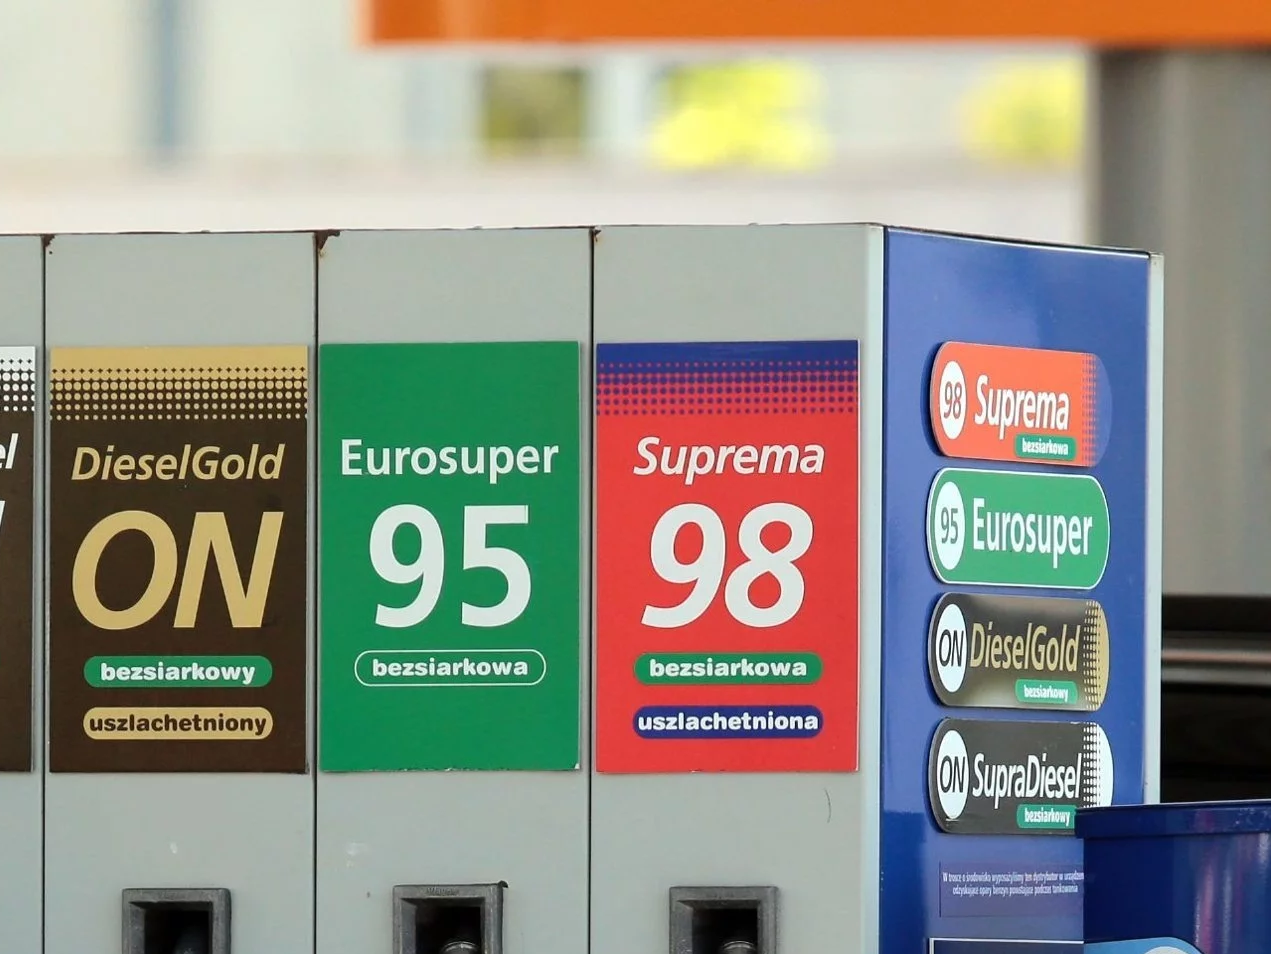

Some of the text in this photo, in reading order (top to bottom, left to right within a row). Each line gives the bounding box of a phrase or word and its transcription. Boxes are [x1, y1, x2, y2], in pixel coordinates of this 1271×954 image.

[944, 381, 963, 420] 98
[974, 374, 1070, 440] Suprema
[71, 444, 285, 481] DieselGold
[341, 438, 559, 484] Eurosuper
[633, 437, 825, 485] Suprema
[1022, 437, 1069, 456] bezsiarkowa
[941, 506, 959, 545] 95
[973, 497, 1093, 569] Eurosuper
[72, 510, 284, 630] ON
[369, 503, 532, 628] 95
[640, 502, 814, 629] 98
[938, 628, 964, 667] ON
[969, 621, 1081, 672] DieselGold
[100, 661, 256, 685] bezsiarkowy
[372, 657, 528, 677] bezsiarkowa
[649, 658, 807, 677] bezsiarkowa
[1023, 684, 1069, 703] bezsiarkowy
[89, 713, 267, 737] uszlachetniony
[638, 711, 819, 731] uszlachetniona
[940, 755, 966, 794] ON
[972, 752, 1083, 809] SupraDiesel
[1024, 807, 1071, 827] bezsiarkowy
